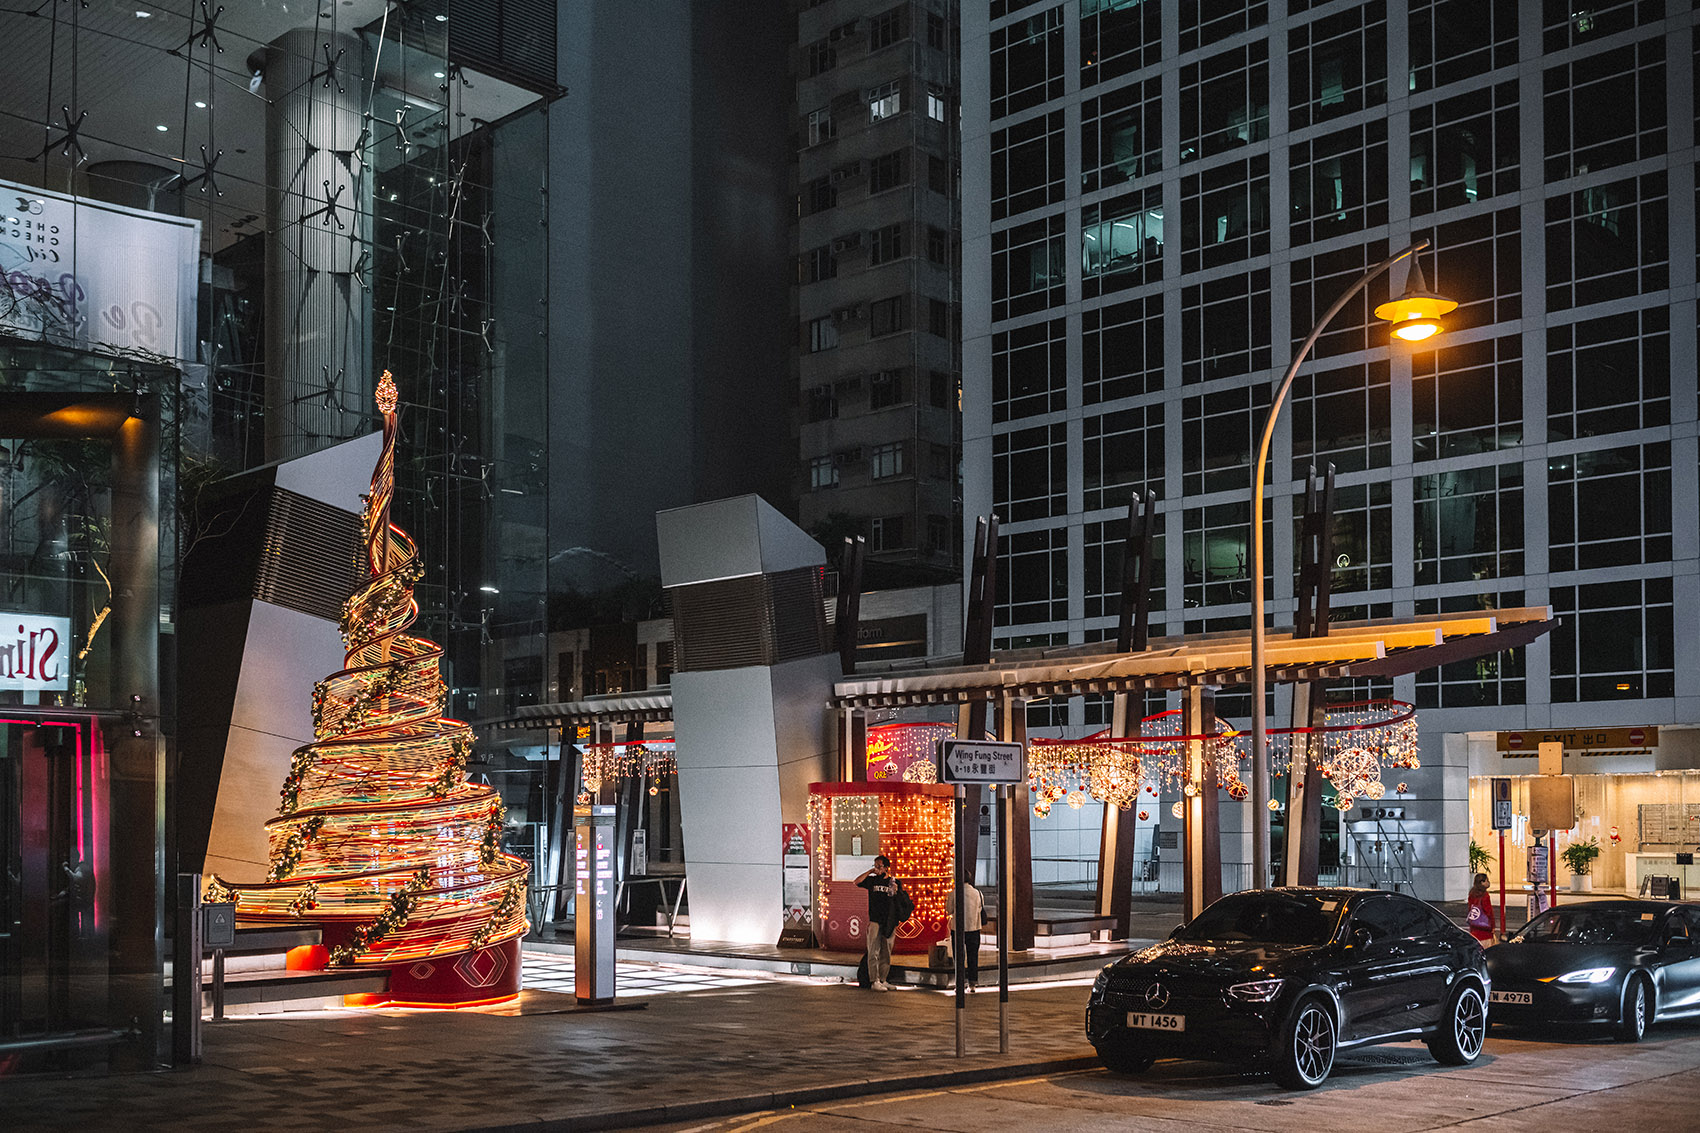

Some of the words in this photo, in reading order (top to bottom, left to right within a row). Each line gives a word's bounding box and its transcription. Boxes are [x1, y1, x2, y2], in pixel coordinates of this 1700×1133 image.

[1583, 734, 1606, 745] 出口
[955, 750, 973, 761] Wing
[975, 751, 991, 762] Fung
[993, 751, 1013, 761] Street
[1503, 993, 1530, 1003] 4978
[1133, 1014, 1147, 1026] WT
[1151, 1015, 1177, 1028] 1456
